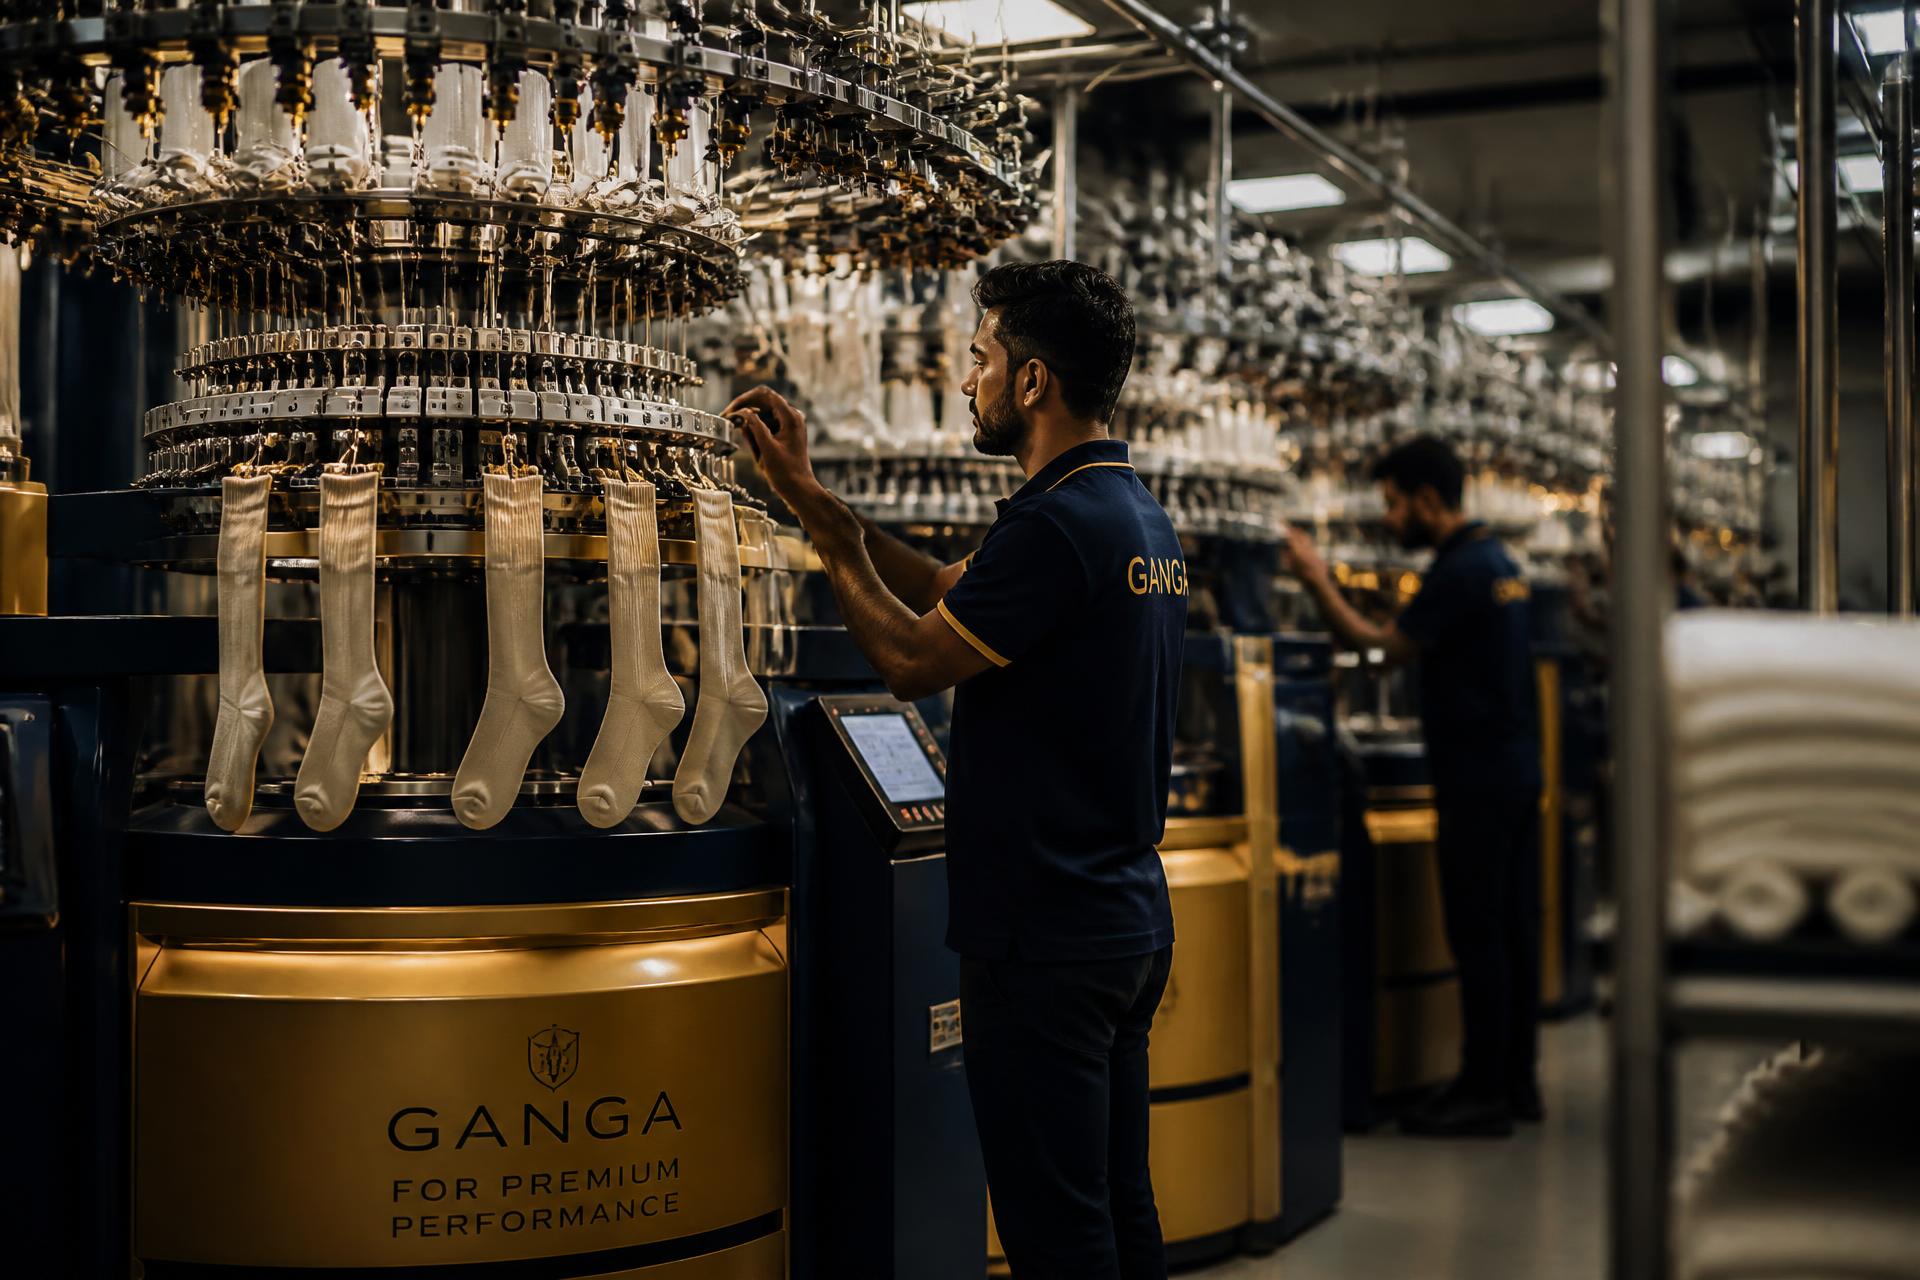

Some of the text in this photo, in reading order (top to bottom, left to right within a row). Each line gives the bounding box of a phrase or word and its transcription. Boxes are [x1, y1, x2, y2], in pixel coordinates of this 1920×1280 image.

[388, 1091, 683, 1152] GANGA
[392, 1157, 680, 1203] FOR PREMIUM
[391, 1192, 680, 1239] PERFORMANCE
